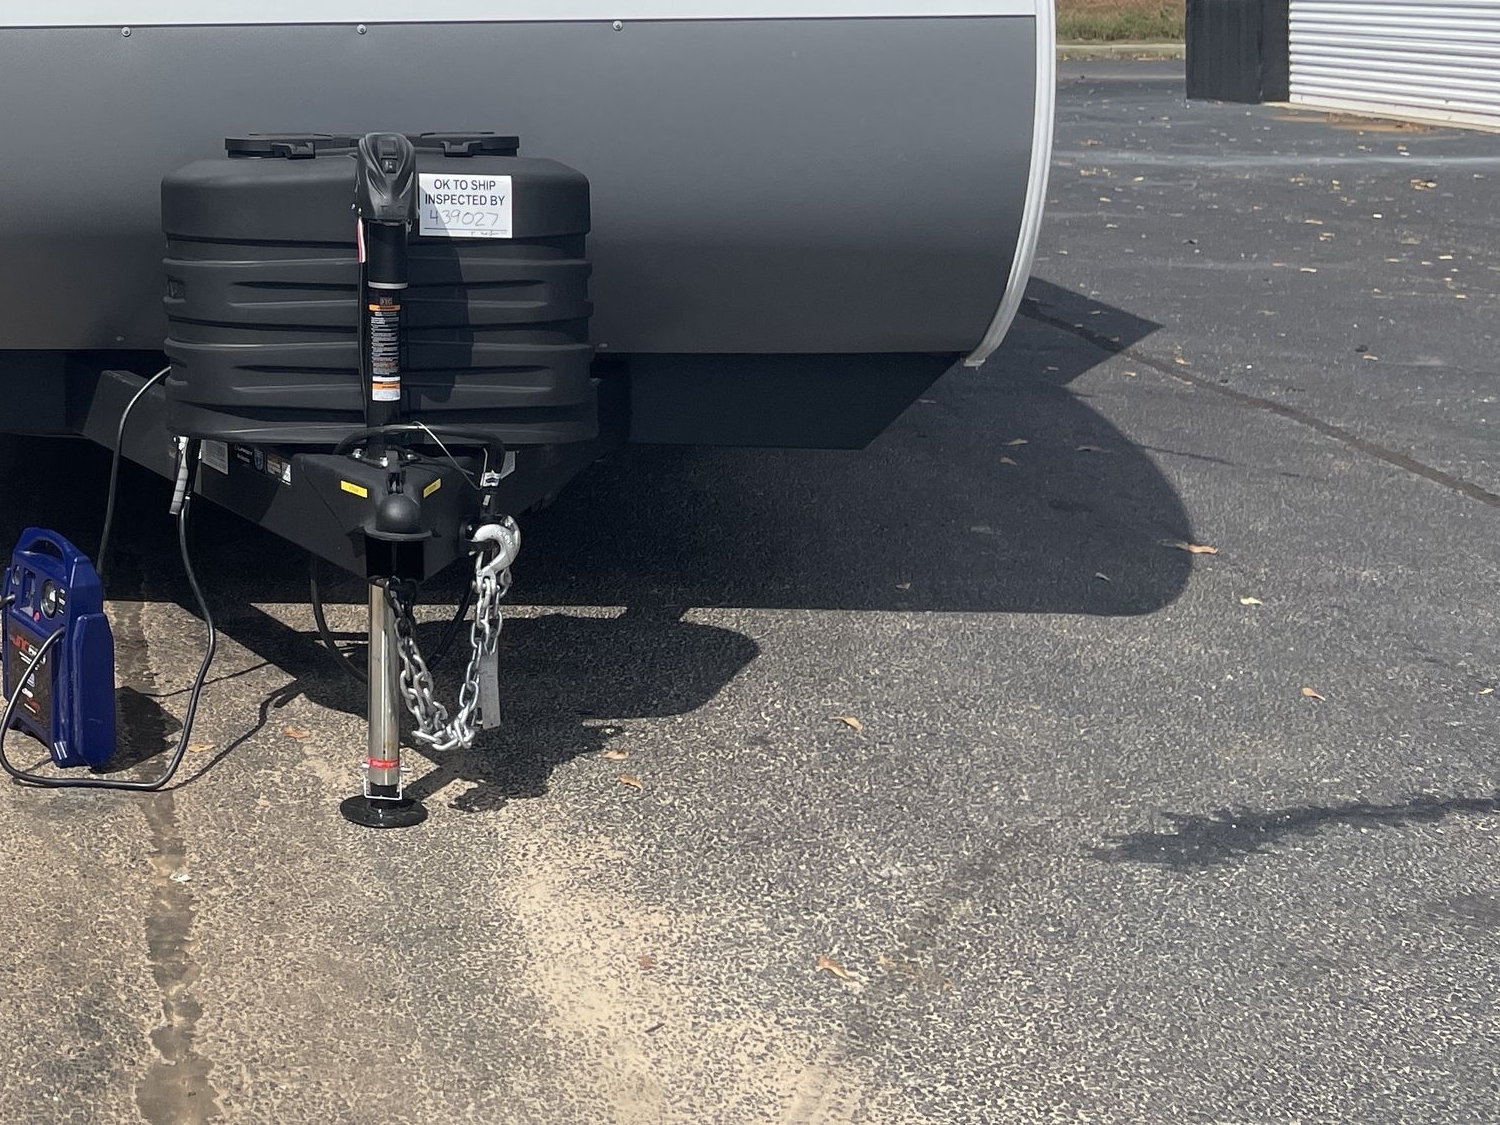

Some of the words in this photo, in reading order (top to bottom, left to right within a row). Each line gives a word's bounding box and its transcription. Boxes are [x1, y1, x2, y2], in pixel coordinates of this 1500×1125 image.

[433, 178, 451, 190] OK
[453, 179, 468, 191] TO
[471, 179, 496, 191] SHIP
[424, 193, 487, 206] INSPECTED
[490, 195, 506, 206] BY
[429, 208, 499, 227] 439027
